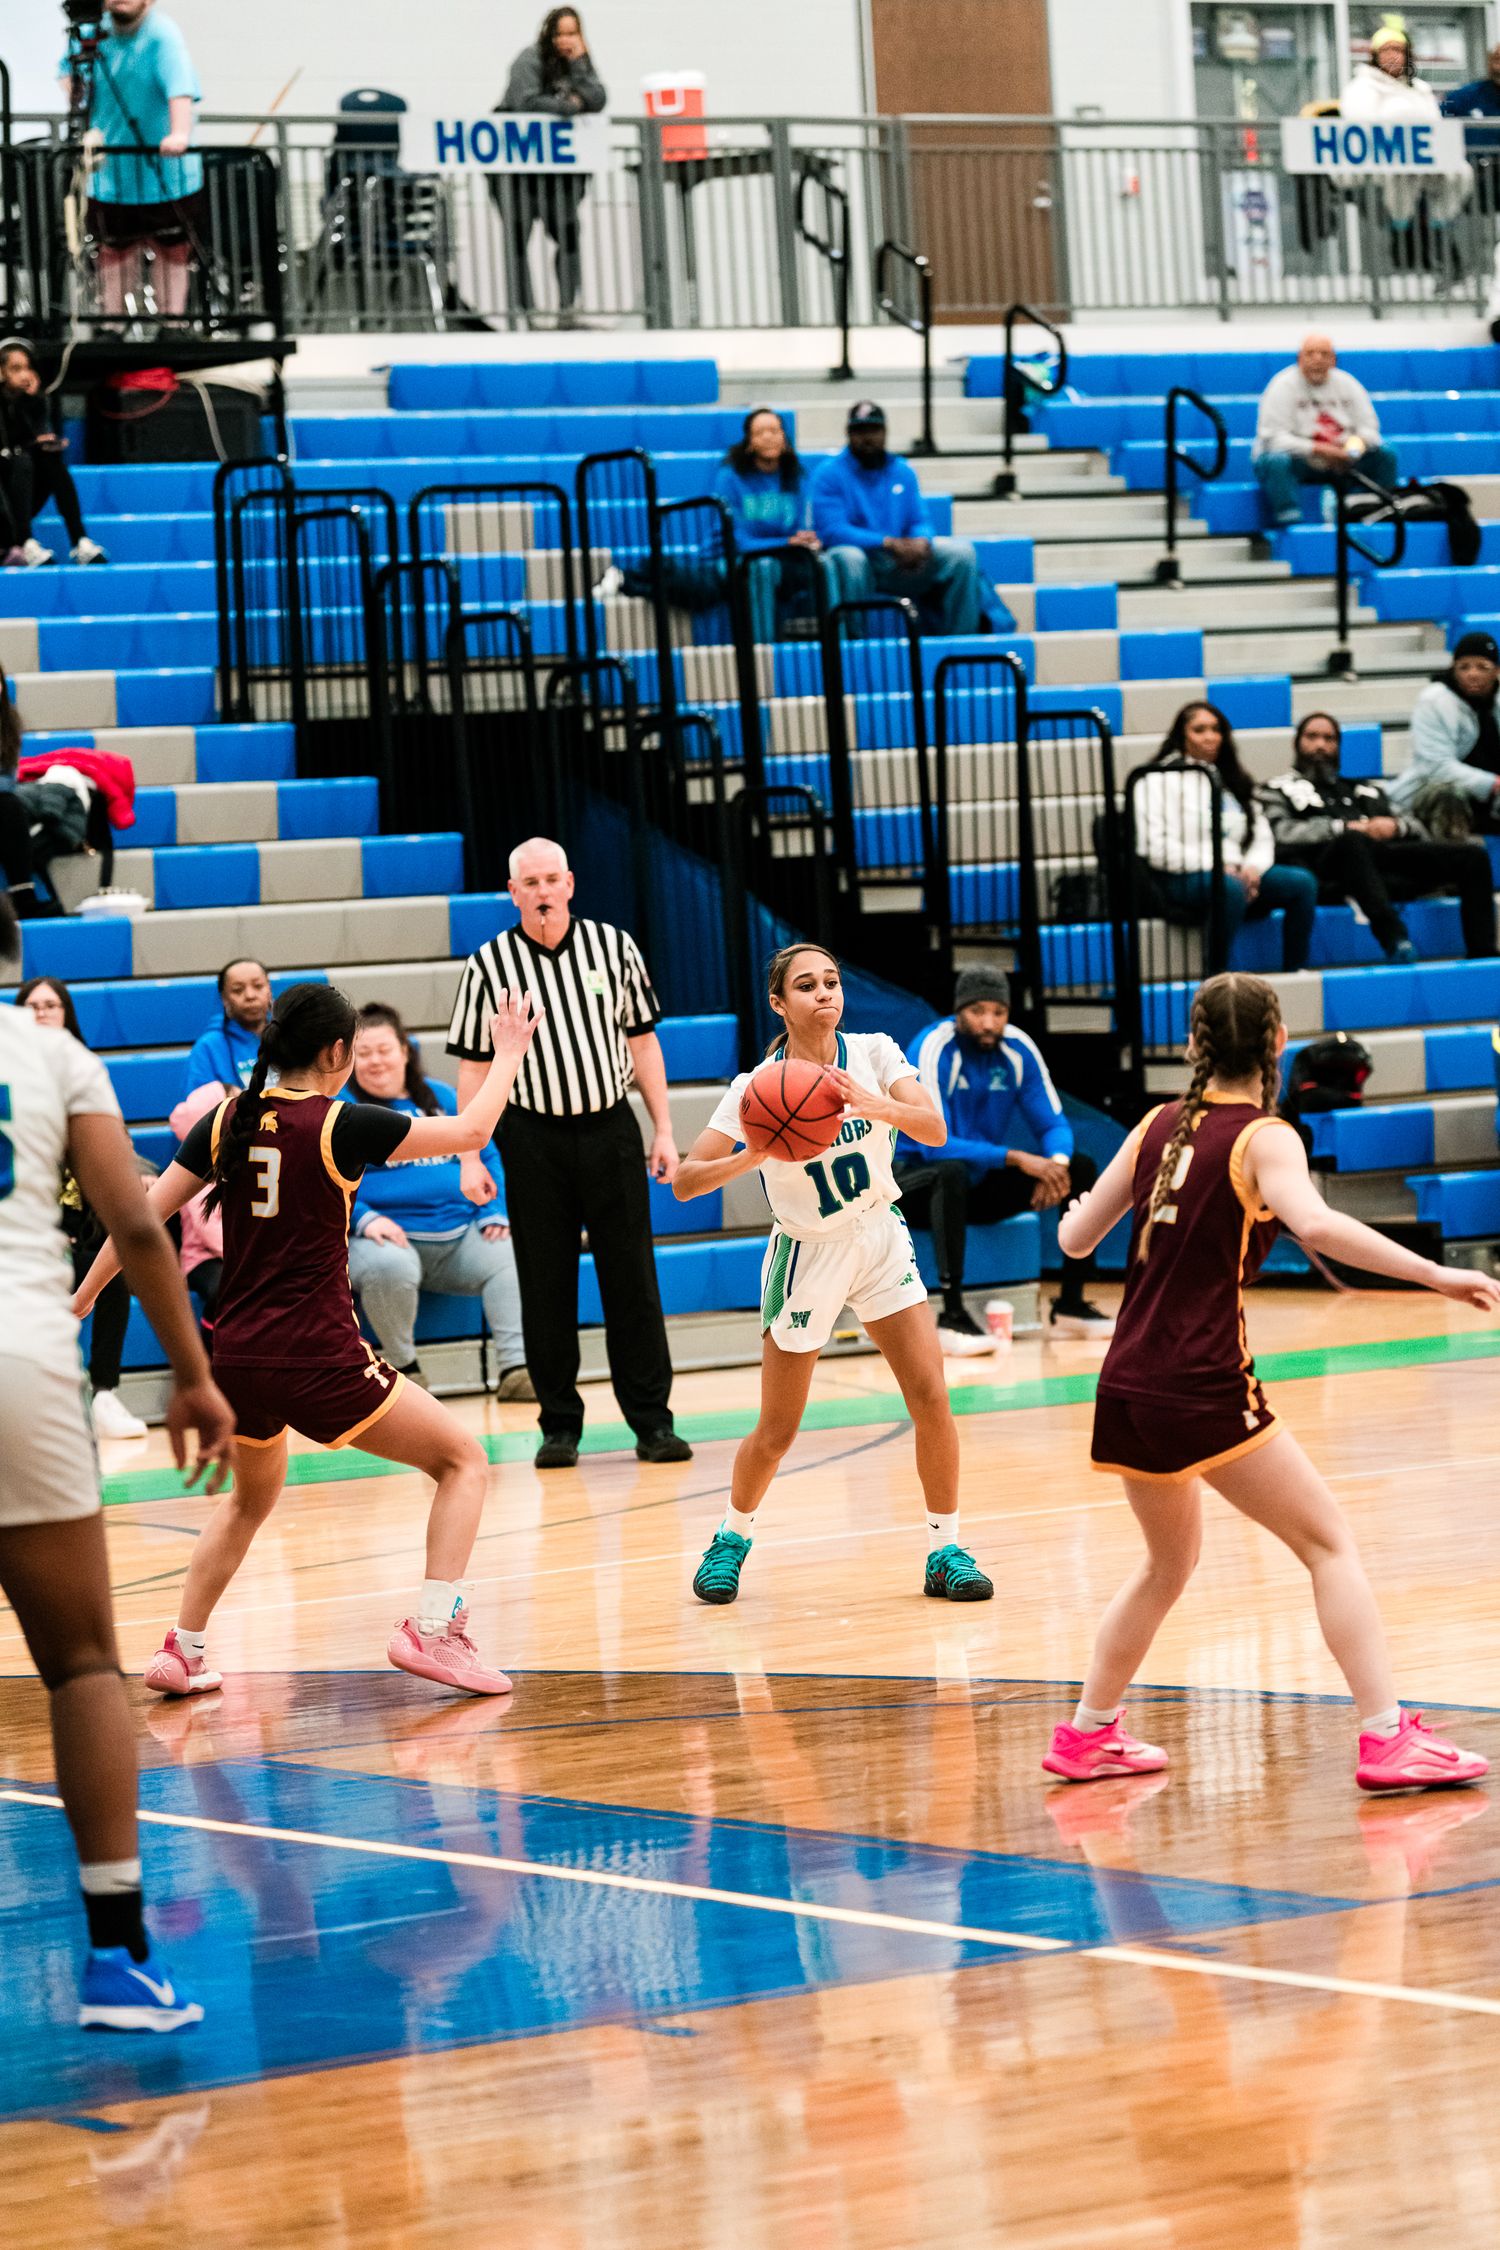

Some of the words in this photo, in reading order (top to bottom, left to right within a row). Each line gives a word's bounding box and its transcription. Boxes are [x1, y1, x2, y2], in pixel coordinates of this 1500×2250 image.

[436, 121, 576, 164] HOME
[1313, 126, 1434, 165] HOME
[248, 1146, 282, 1218] 3
[803, 1152, 871, 1219] 10
